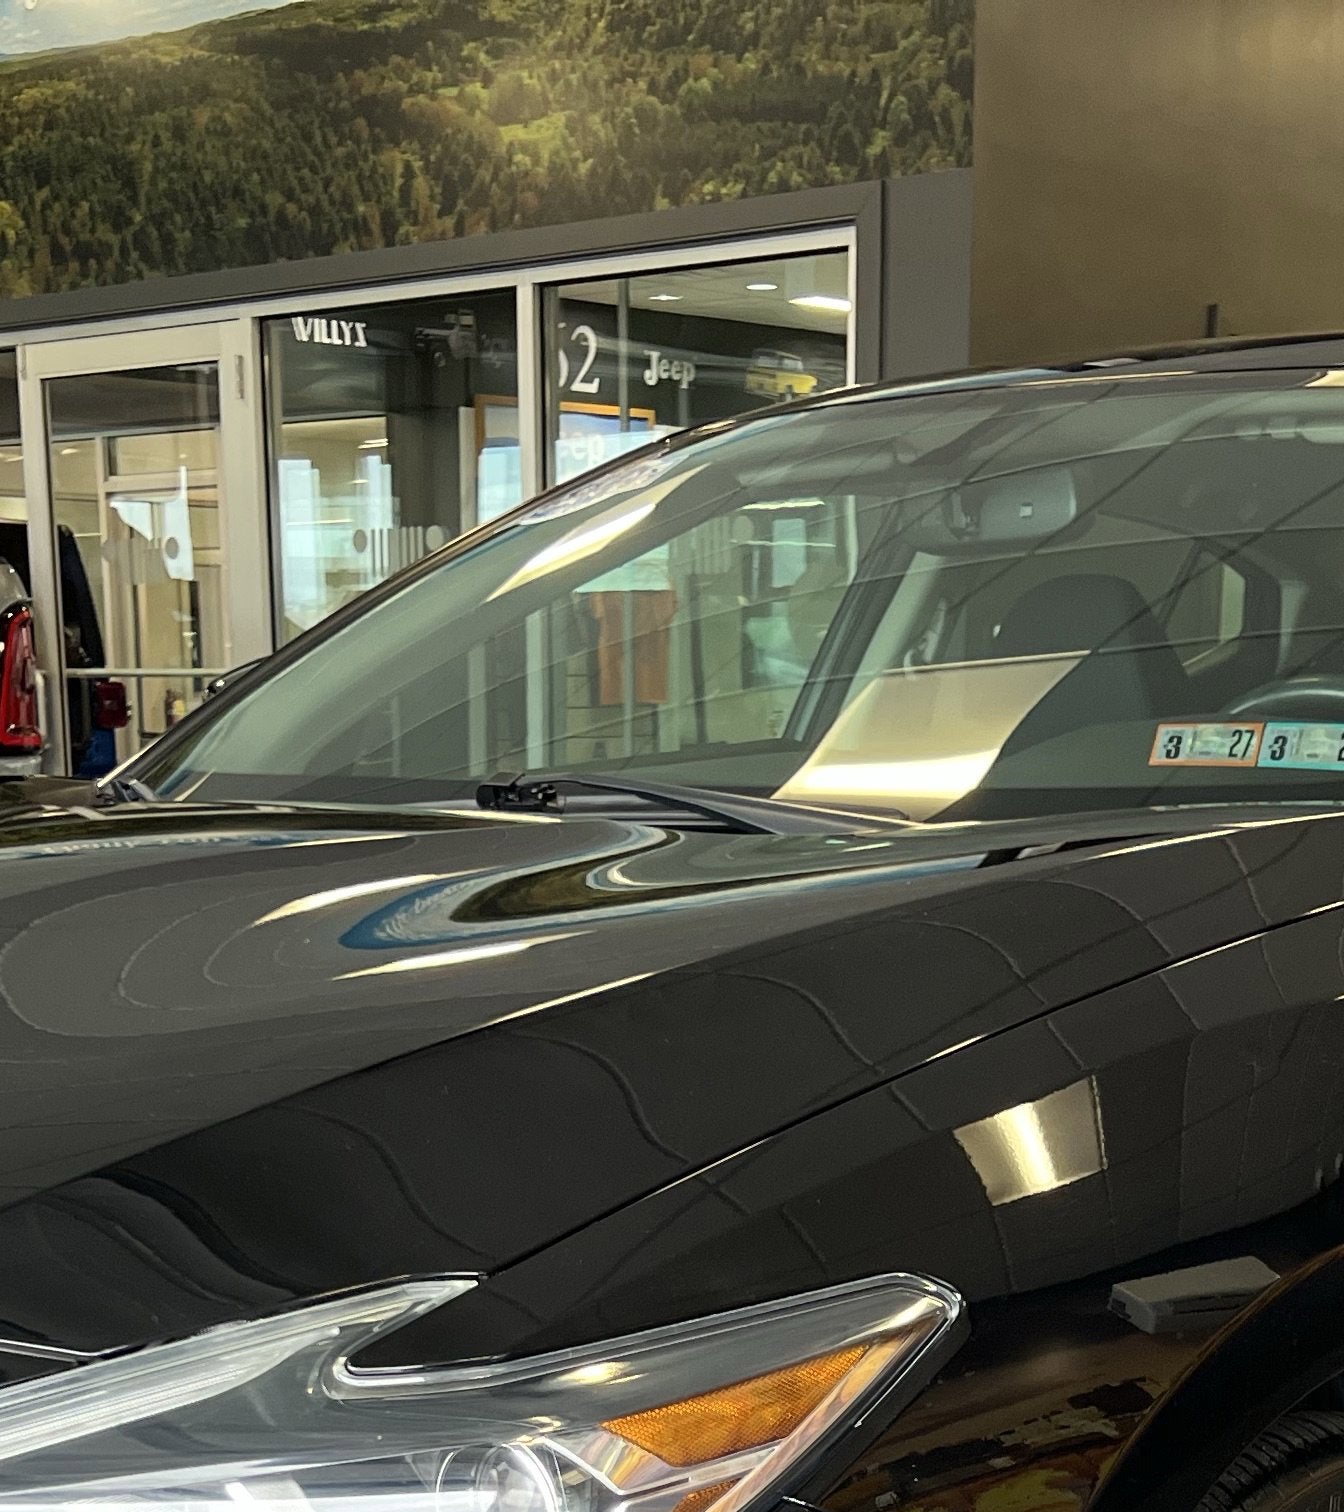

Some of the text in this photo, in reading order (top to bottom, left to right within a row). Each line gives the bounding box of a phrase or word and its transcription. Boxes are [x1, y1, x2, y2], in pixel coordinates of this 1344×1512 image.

[643, 350, 696, 389] Jeep
[1165, 729, 1255, 760] 3 27
[1270, 735, 1288, 761] 3
